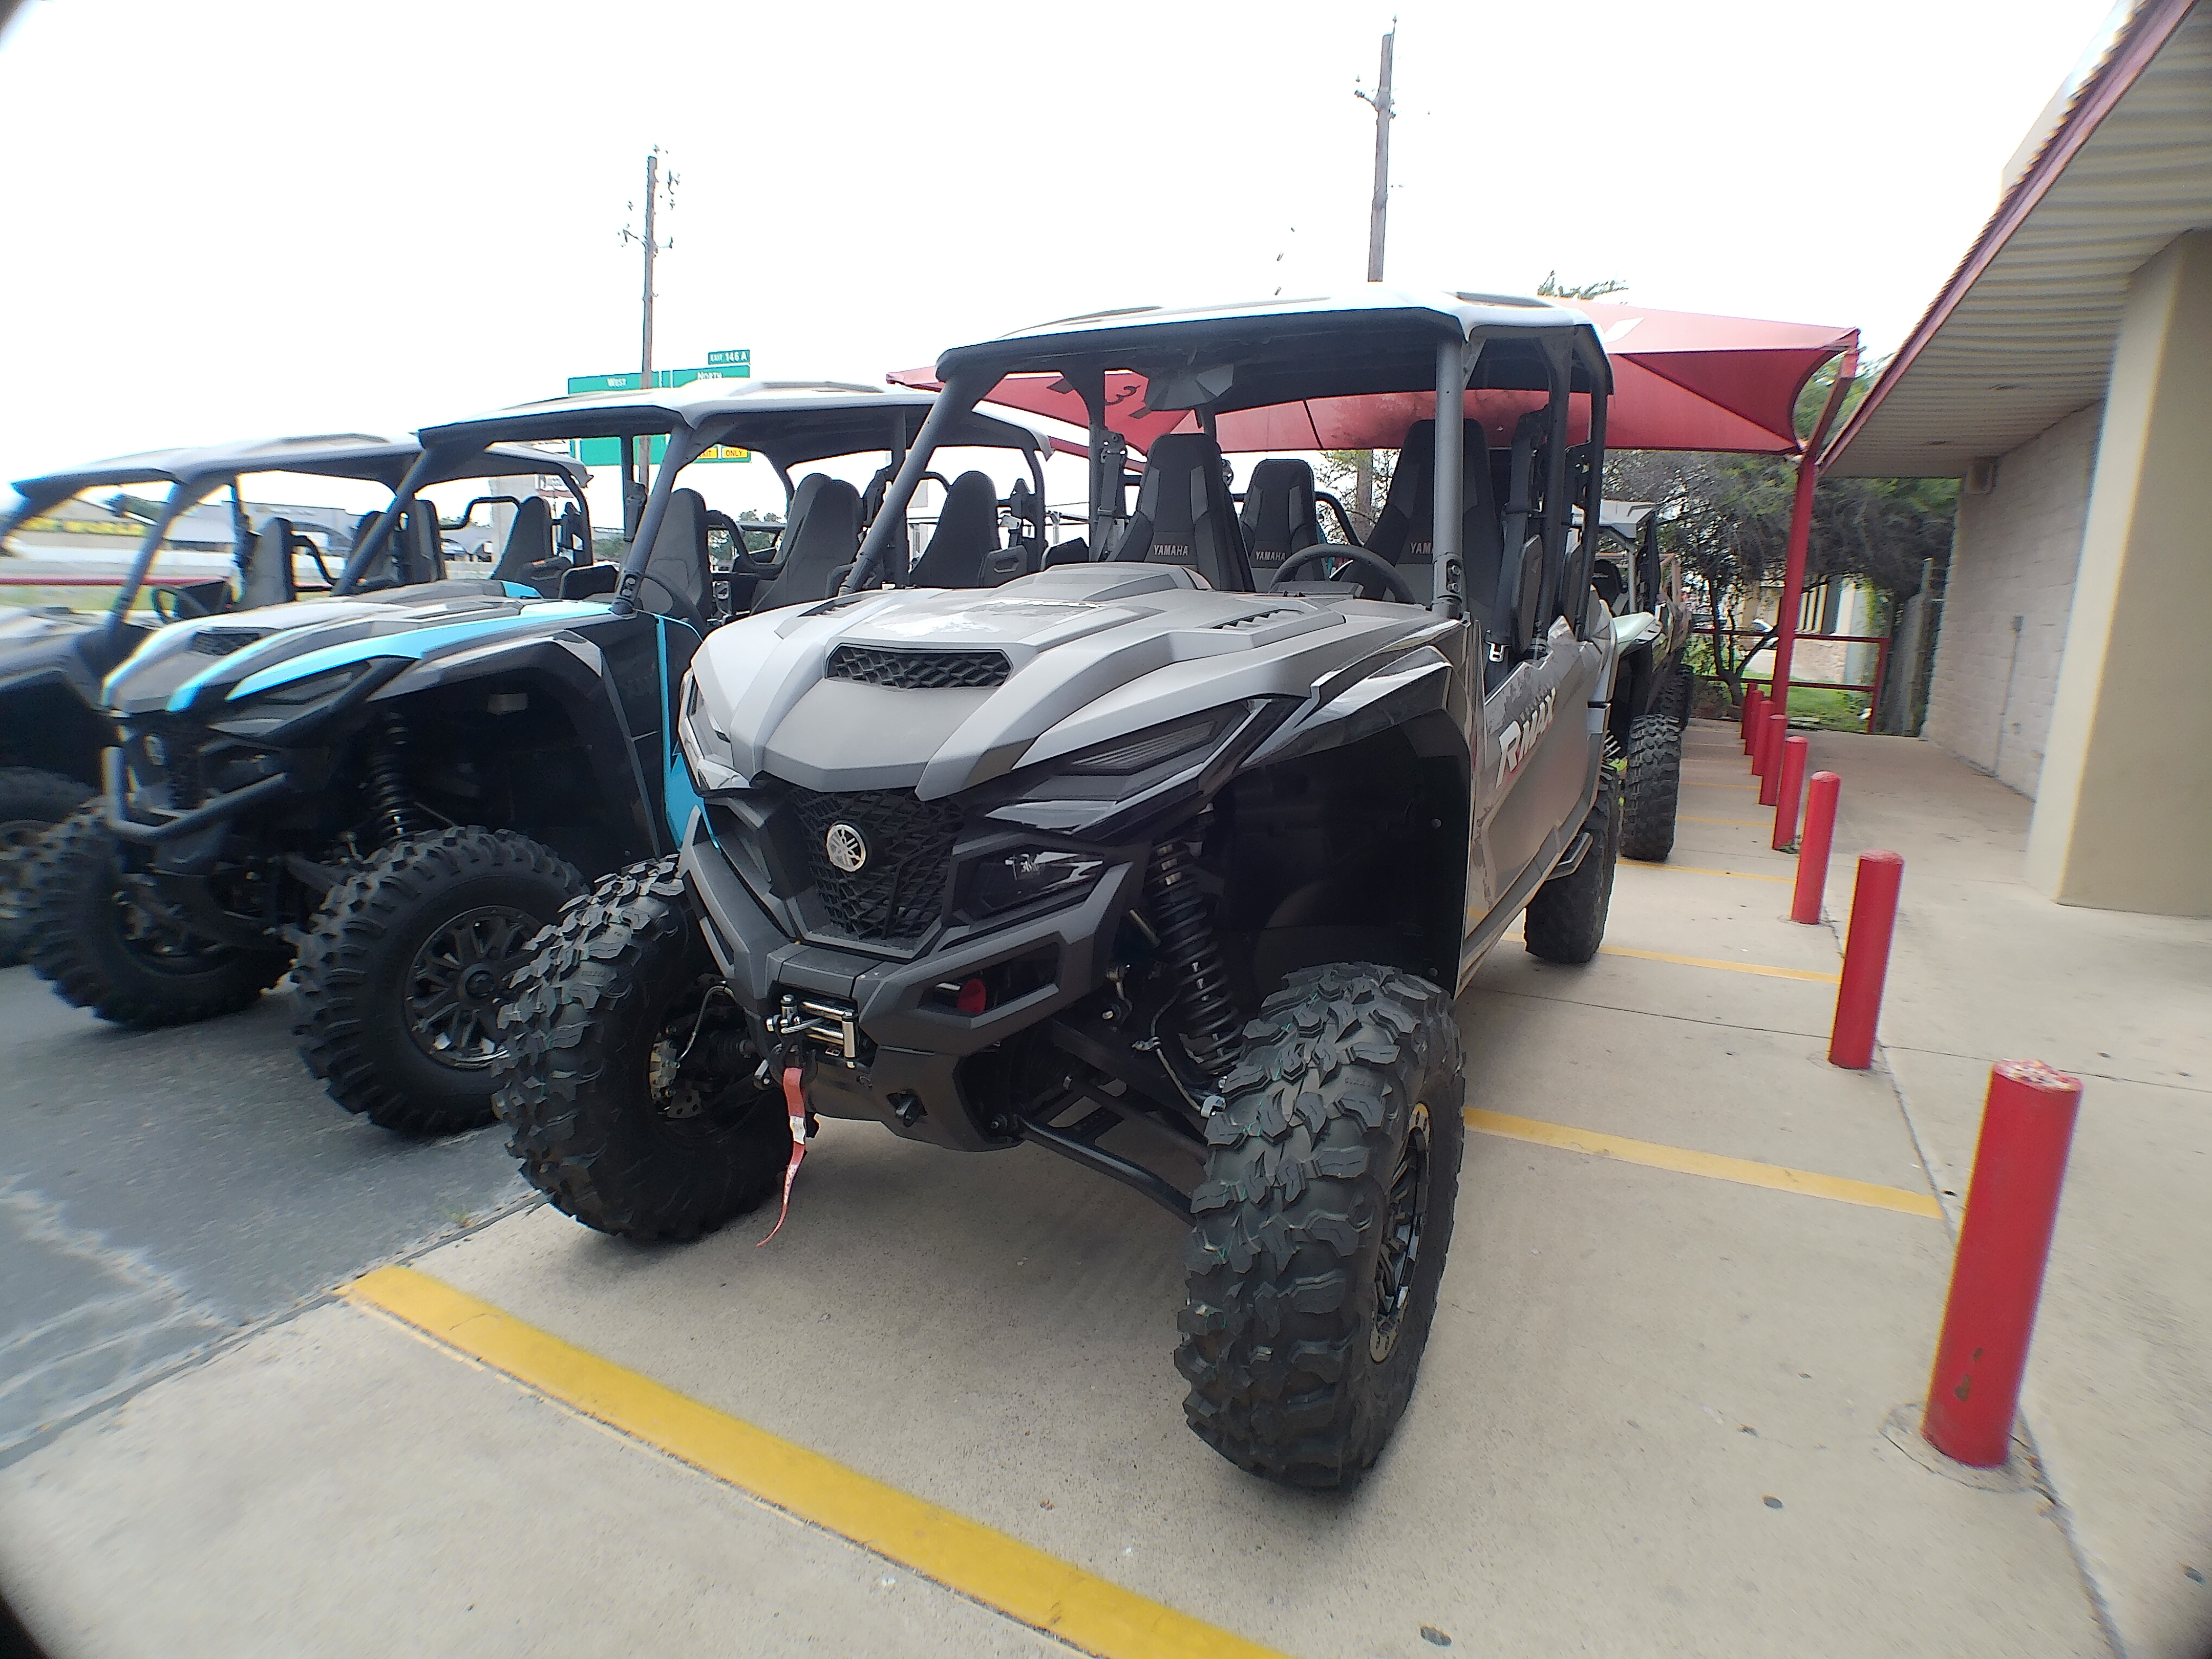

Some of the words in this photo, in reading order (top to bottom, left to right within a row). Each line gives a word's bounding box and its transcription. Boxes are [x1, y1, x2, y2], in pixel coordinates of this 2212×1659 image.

[607, 377, 626, 387] WEST
[1154, 544, 1189, 557] YAMAHA
[1410, 542, 1433, 554] YAM
[1256, 551, 1286, 561] YAMAHA
